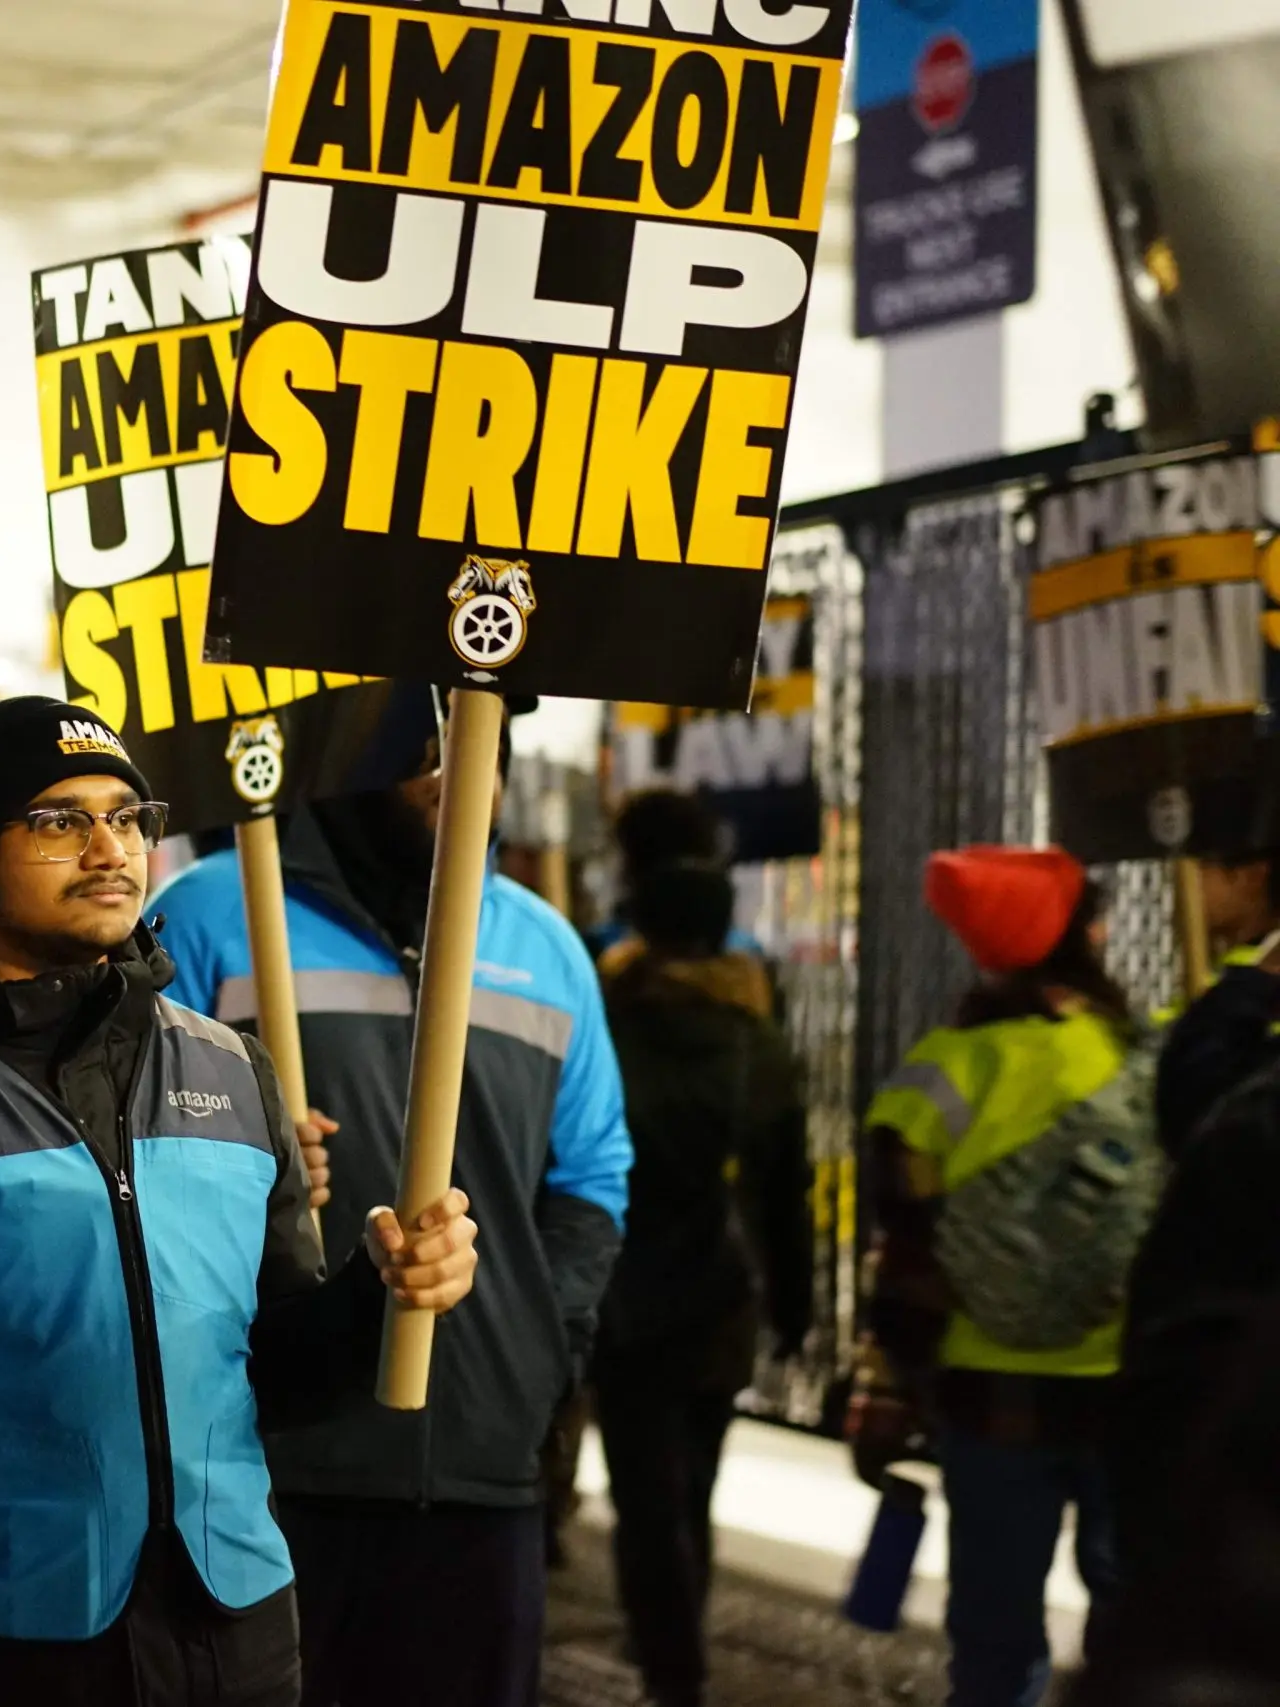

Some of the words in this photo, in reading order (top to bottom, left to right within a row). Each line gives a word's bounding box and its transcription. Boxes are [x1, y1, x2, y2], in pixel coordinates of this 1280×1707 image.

[290, 12, 822, 221] AMAZON
[257, 179, 808, 356] ULP
[59, 328, 241, 479] AMA
[229, 321, 791, 570] STRIKE
[167, 1090, 232, 1111] amazon
